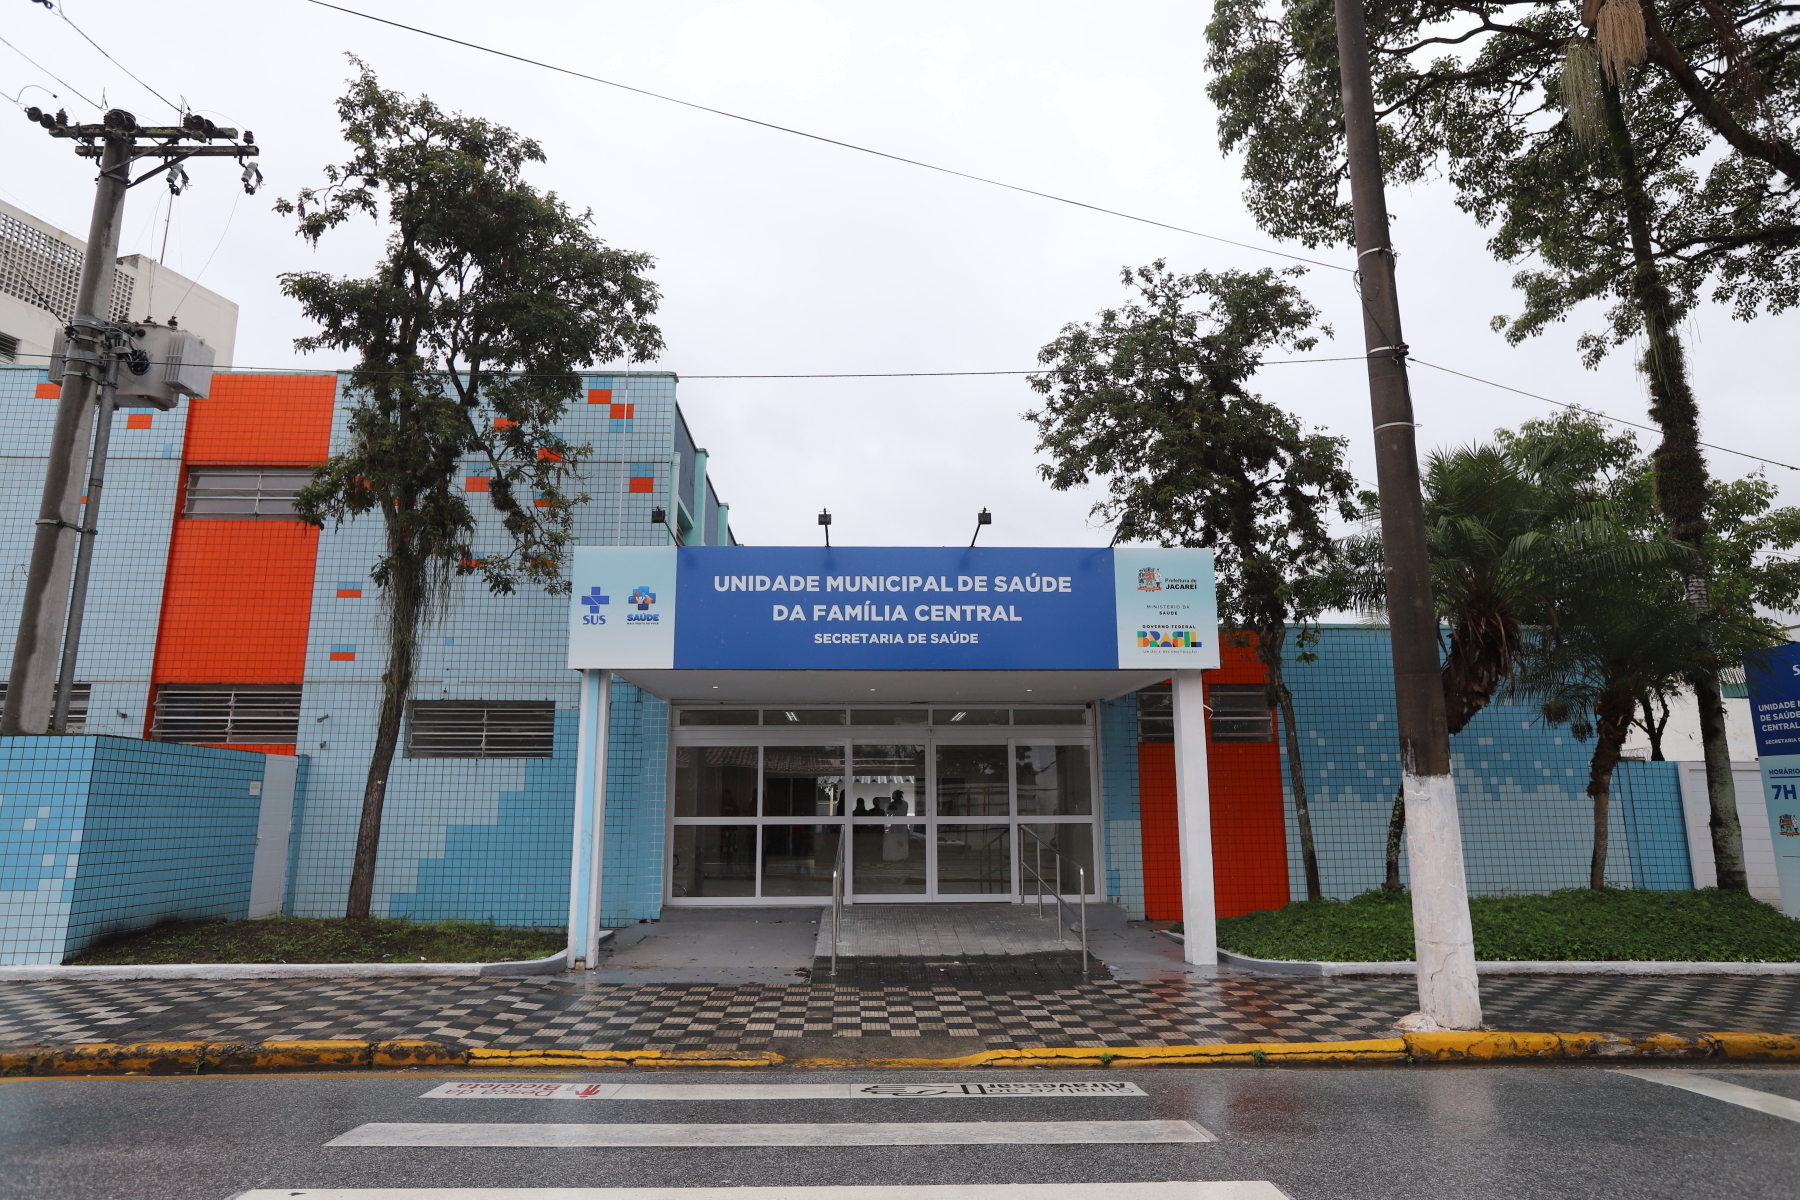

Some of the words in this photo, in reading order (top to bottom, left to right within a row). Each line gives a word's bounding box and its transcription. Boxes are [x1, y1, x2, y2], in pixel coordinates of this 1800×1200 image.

[714, 575, 820, 592] UNIDADE
[826, 575, 954, 592] MUNICIPAL
[957, 575, 988, 592] DE
[994, 572, 1072, 593] SAÚDE
[626, 613, 659, 621] SAÚDE
[772, 604, 806, 621] DA
[813, 600, 908, 621] FAMÍLIA
[914, 604, 1023, 622] CENTRAL
[582, 615, 606, 625] SUS
[814, 633, 904, 644] SECRETARIA
[907, 633, 927, 644] DE
[930, 630, 979, 644] SAÚDE
[1136, 631, 1202, 647] BRASIL
[1758, 700, 1796, 712] UNIDADE
[1760, 714, 1771, 722] DE
[1772, 710, 1800, 721] SAÚDE
[1761, 722, 1800, 732] CENTRAL
[1771, 784, 1798, 800] 7H
[456, 1083, 563, 1091] Bicicleta
[481, 1089, 554, 1097] Desça
